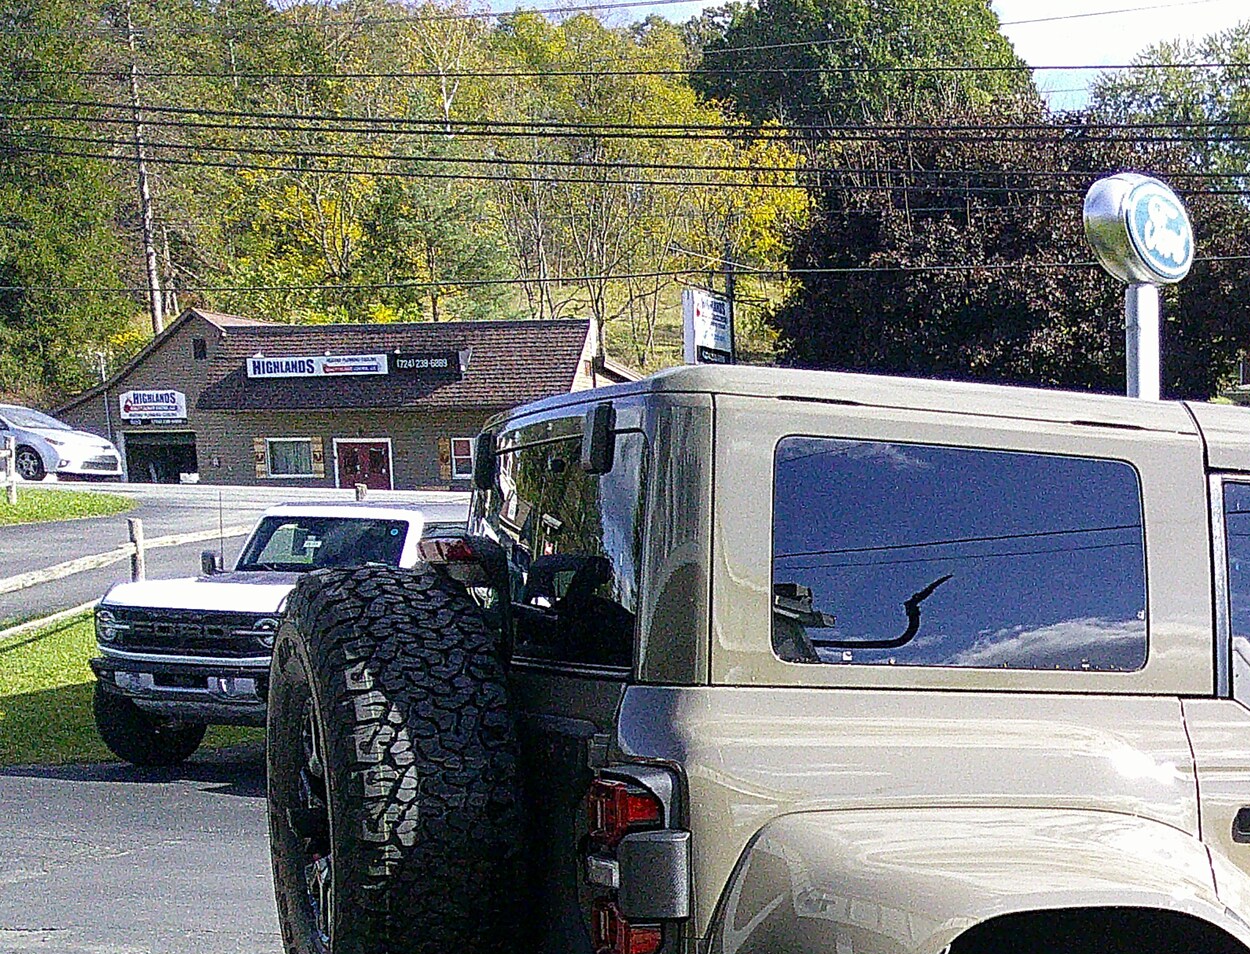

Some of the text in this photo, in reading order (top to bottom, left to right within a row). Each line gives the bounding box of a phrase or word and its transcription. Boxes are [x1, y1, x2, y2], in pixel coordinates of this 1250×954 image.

[252, 358, 315, 376] HIGHLANDS
[396, 359, 415, 369] (724)
[132, 392, 176, 405] HIGHLANDS
